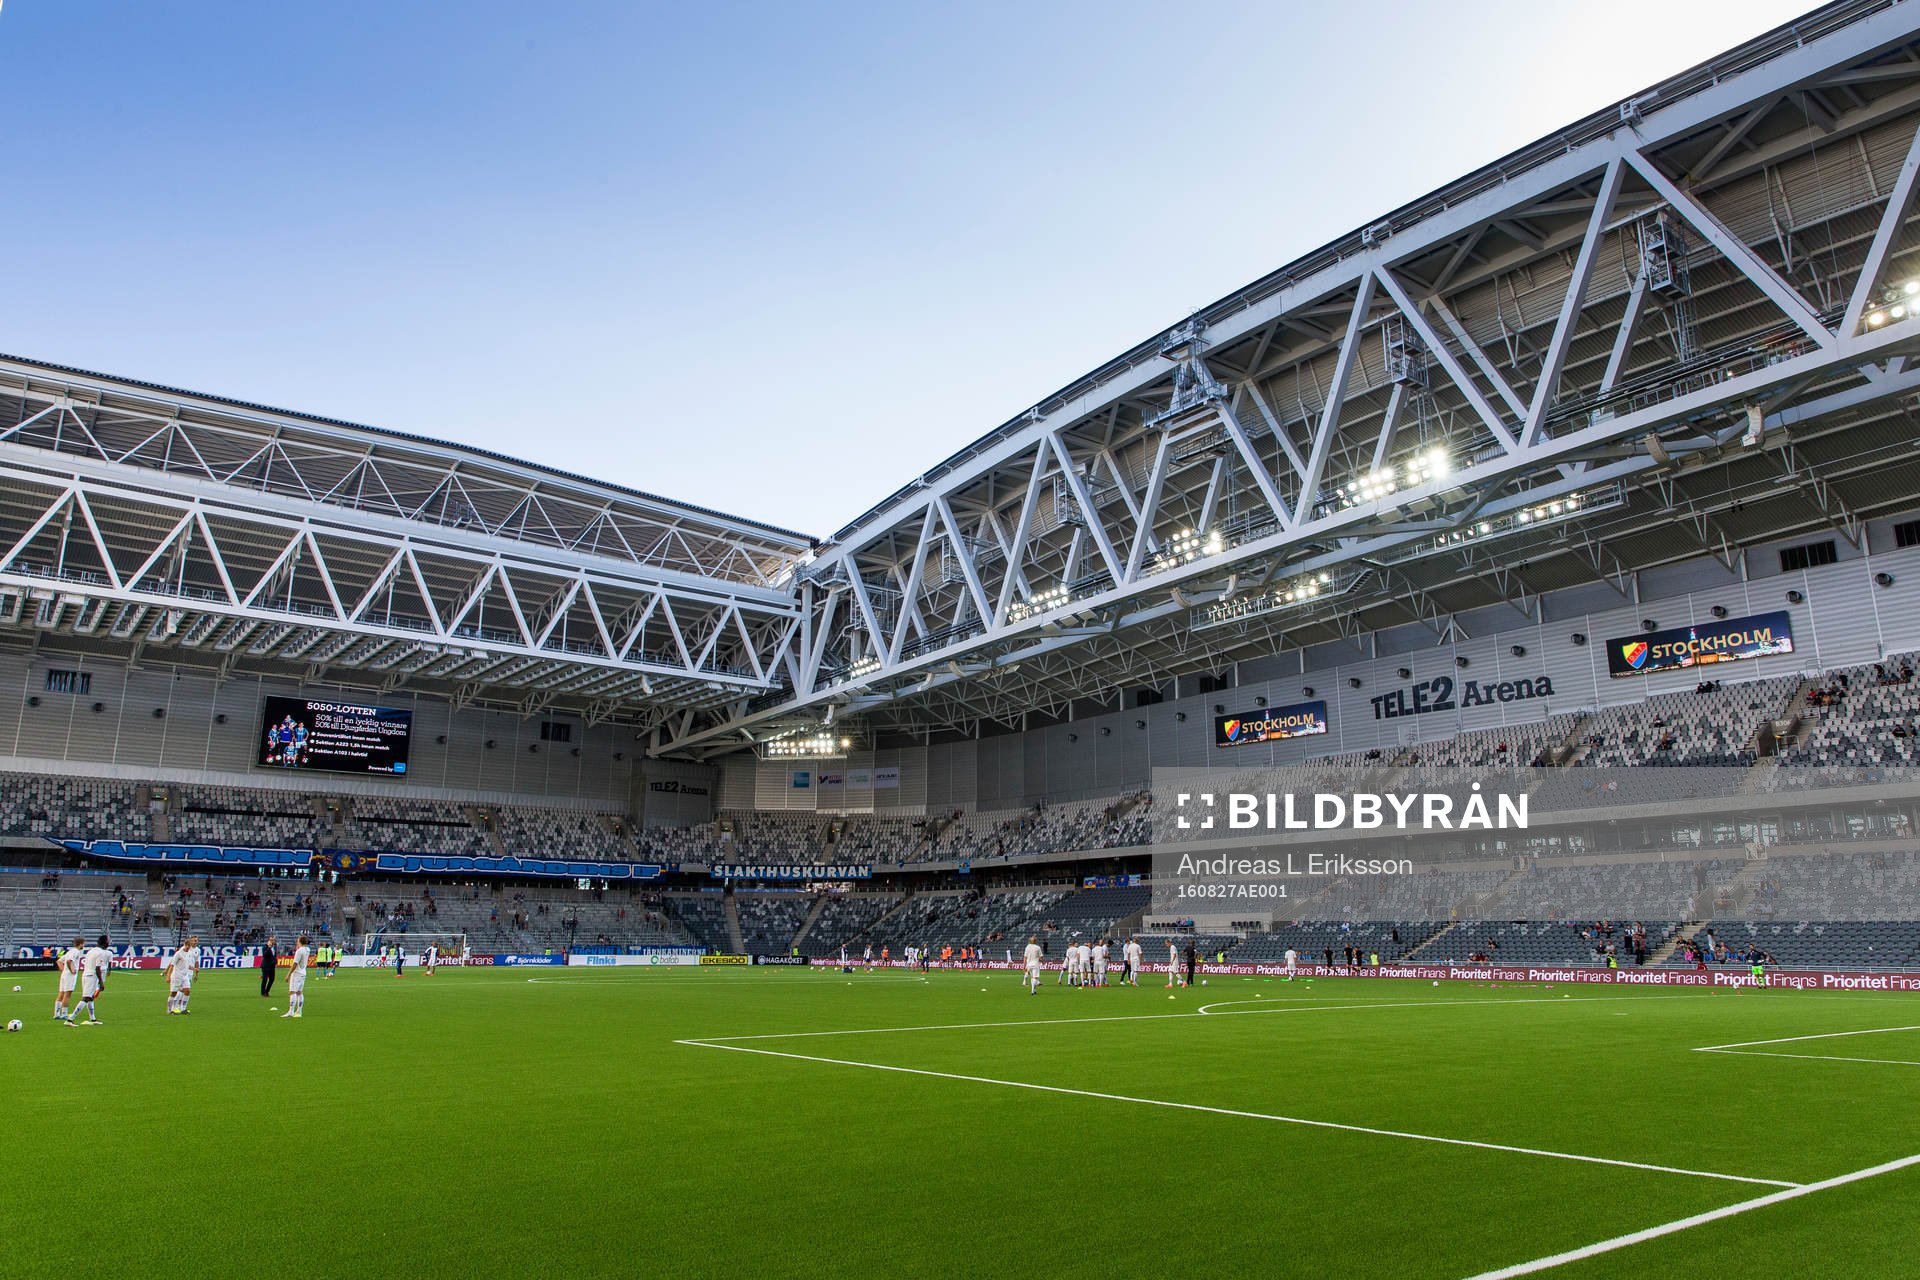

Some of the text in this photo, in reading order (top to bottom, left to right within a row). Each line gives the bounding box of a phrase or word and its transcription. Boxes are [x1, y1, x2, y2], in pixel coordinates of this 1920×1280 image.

[1652, 627, 1772, 659] STOCKHOLM
[1370, 675, 1555, 720] TELE2 Arena
[307, 702, 376, 716] 5050-LOTTEN
[316, 714, 332, 722] 50%
[1242, 713, 1314, 734] STOCKHOLM
[650, 781, 679, 793] TELE2
[1202, 964, 1254, 974] Prioritet Finans
[1256, 965, 1288, 975] Prioritet
[1380, 966, 1446, 978] Prioritet Finans
[1450, 968, 1524, 980] Prioritet Finans
[1529, 969, 1612, 982] Prioritet Finans
[1616, 971, 1708, 984] Prioritet Finans
[1773, 974, 1816, 987] Finans
[1824, 975, 1920, 989] Prioritet Fina
